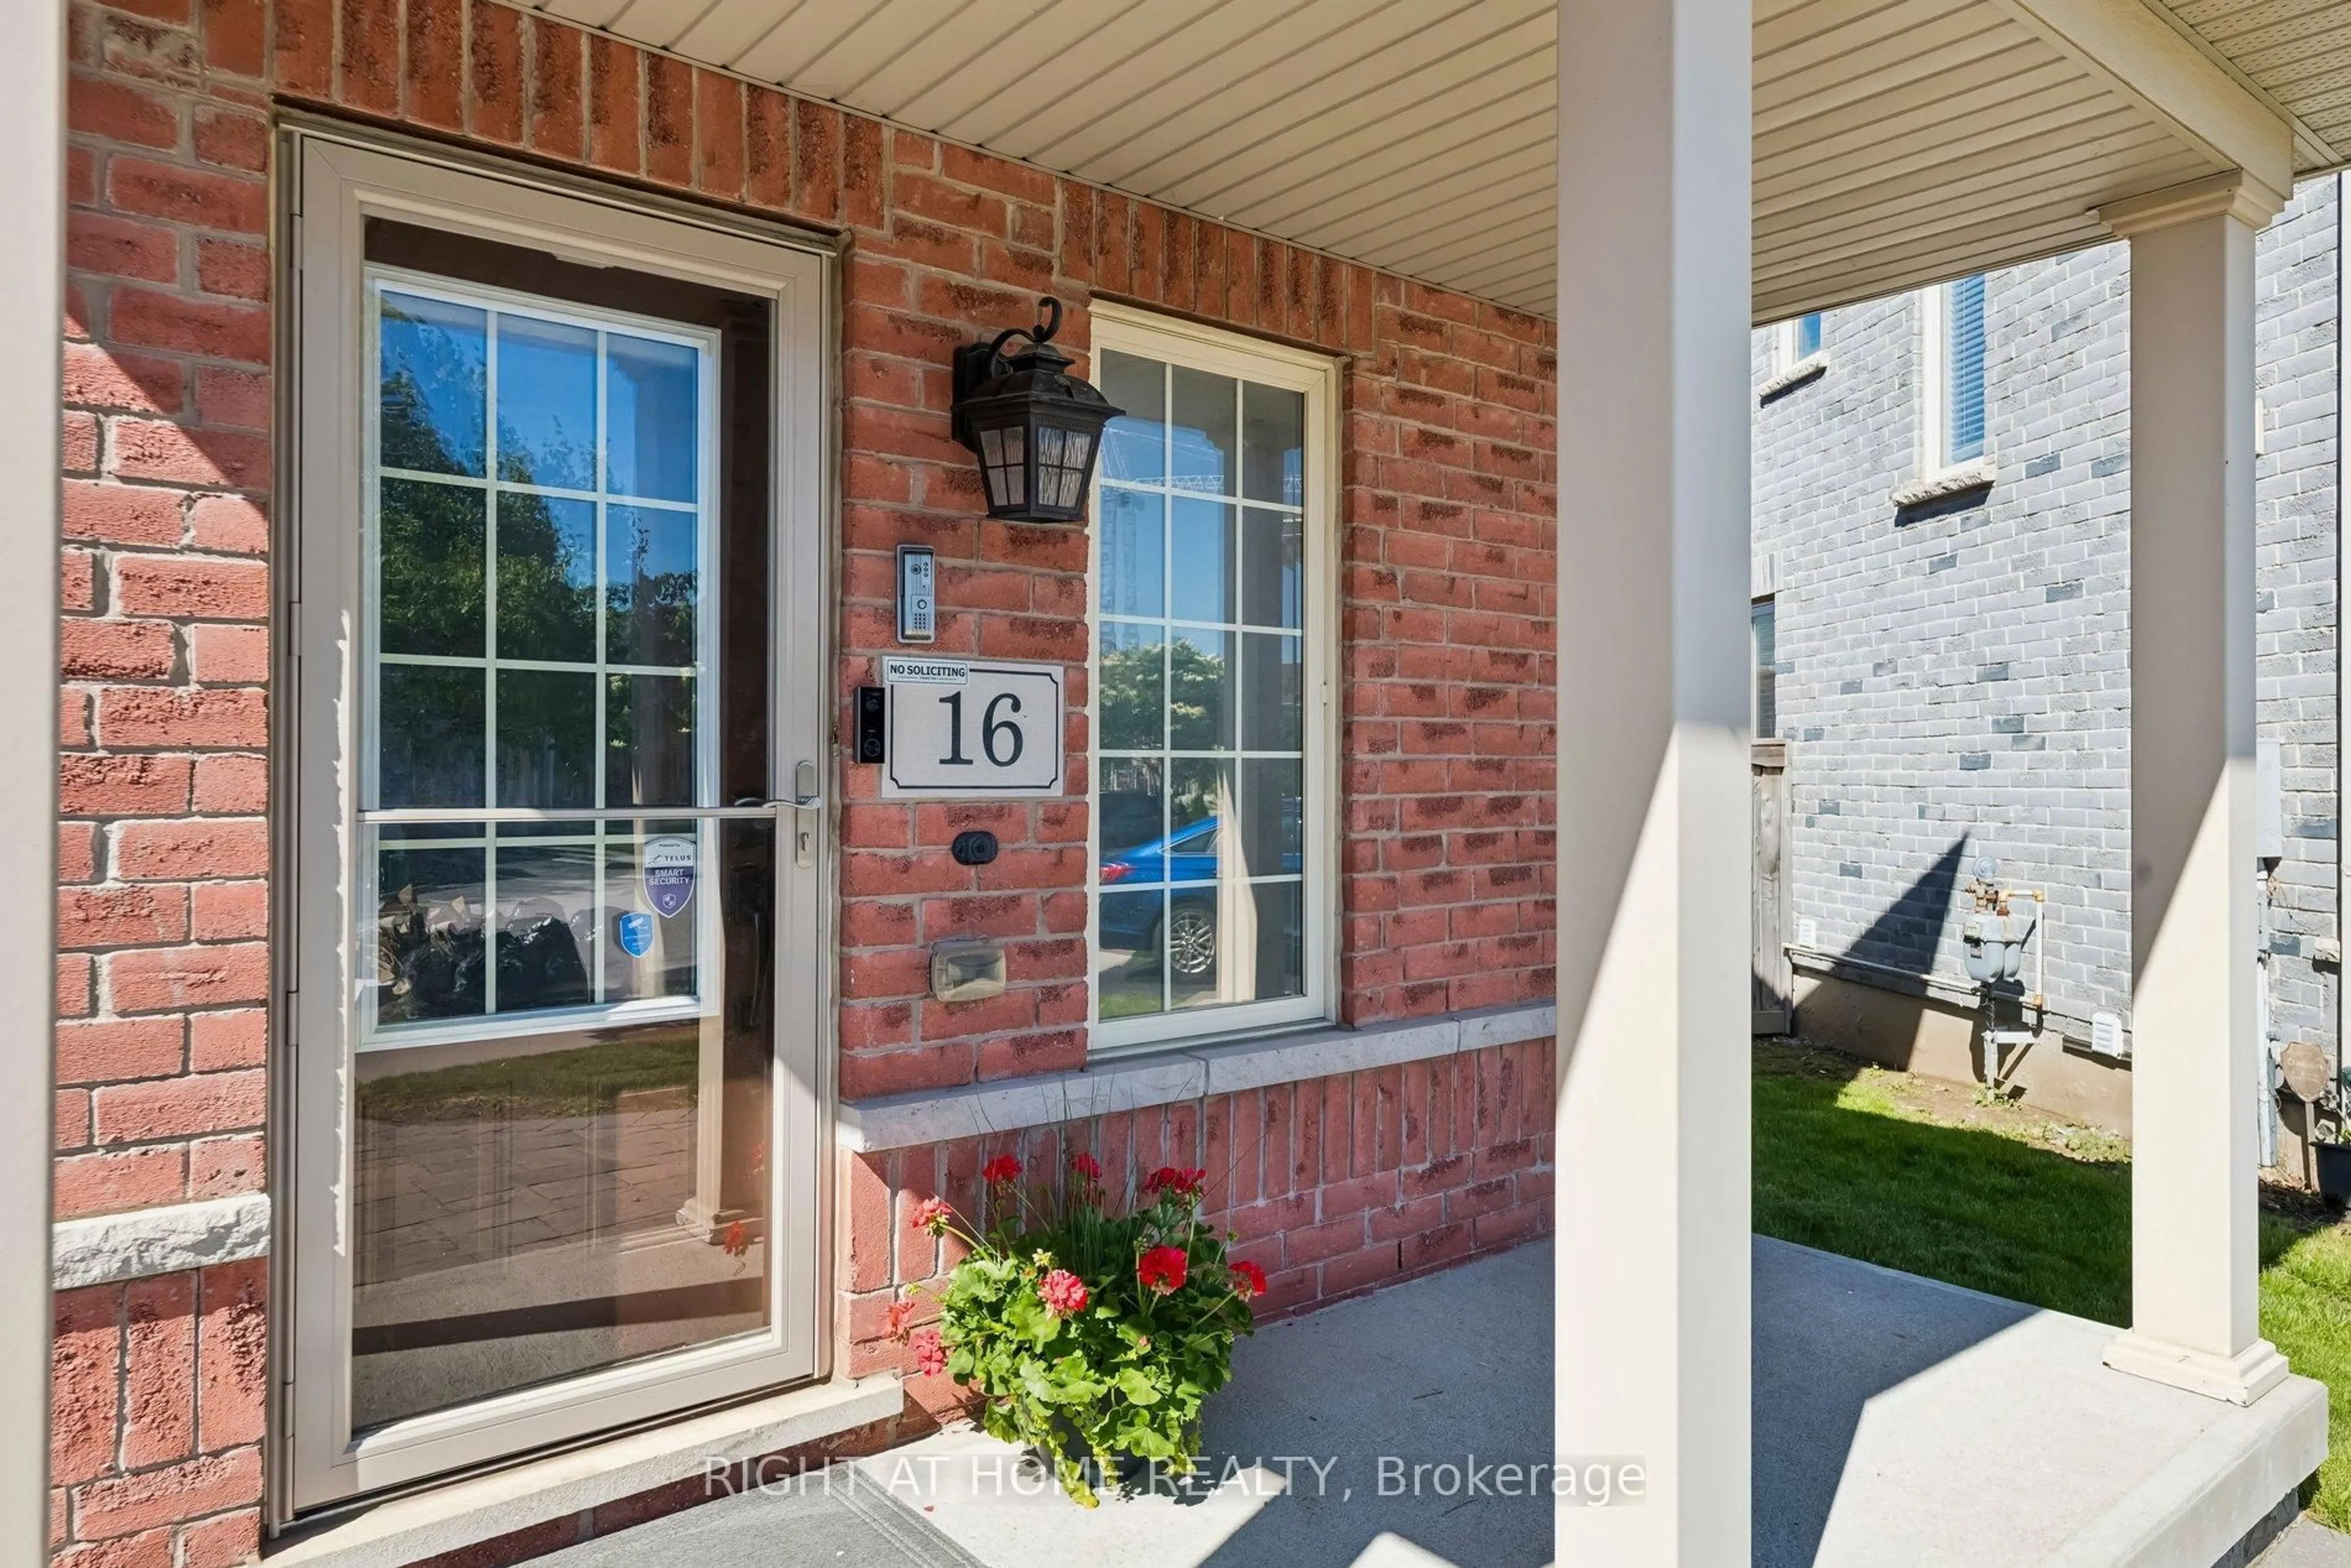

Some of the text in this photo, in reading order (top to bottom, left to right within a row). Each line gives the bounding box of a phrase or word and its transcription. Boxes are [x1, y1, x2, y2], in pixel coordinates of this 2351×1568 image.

[890, 664, 965, 677] NO SOLICITING
[939, 691, 1023, 767] 16
